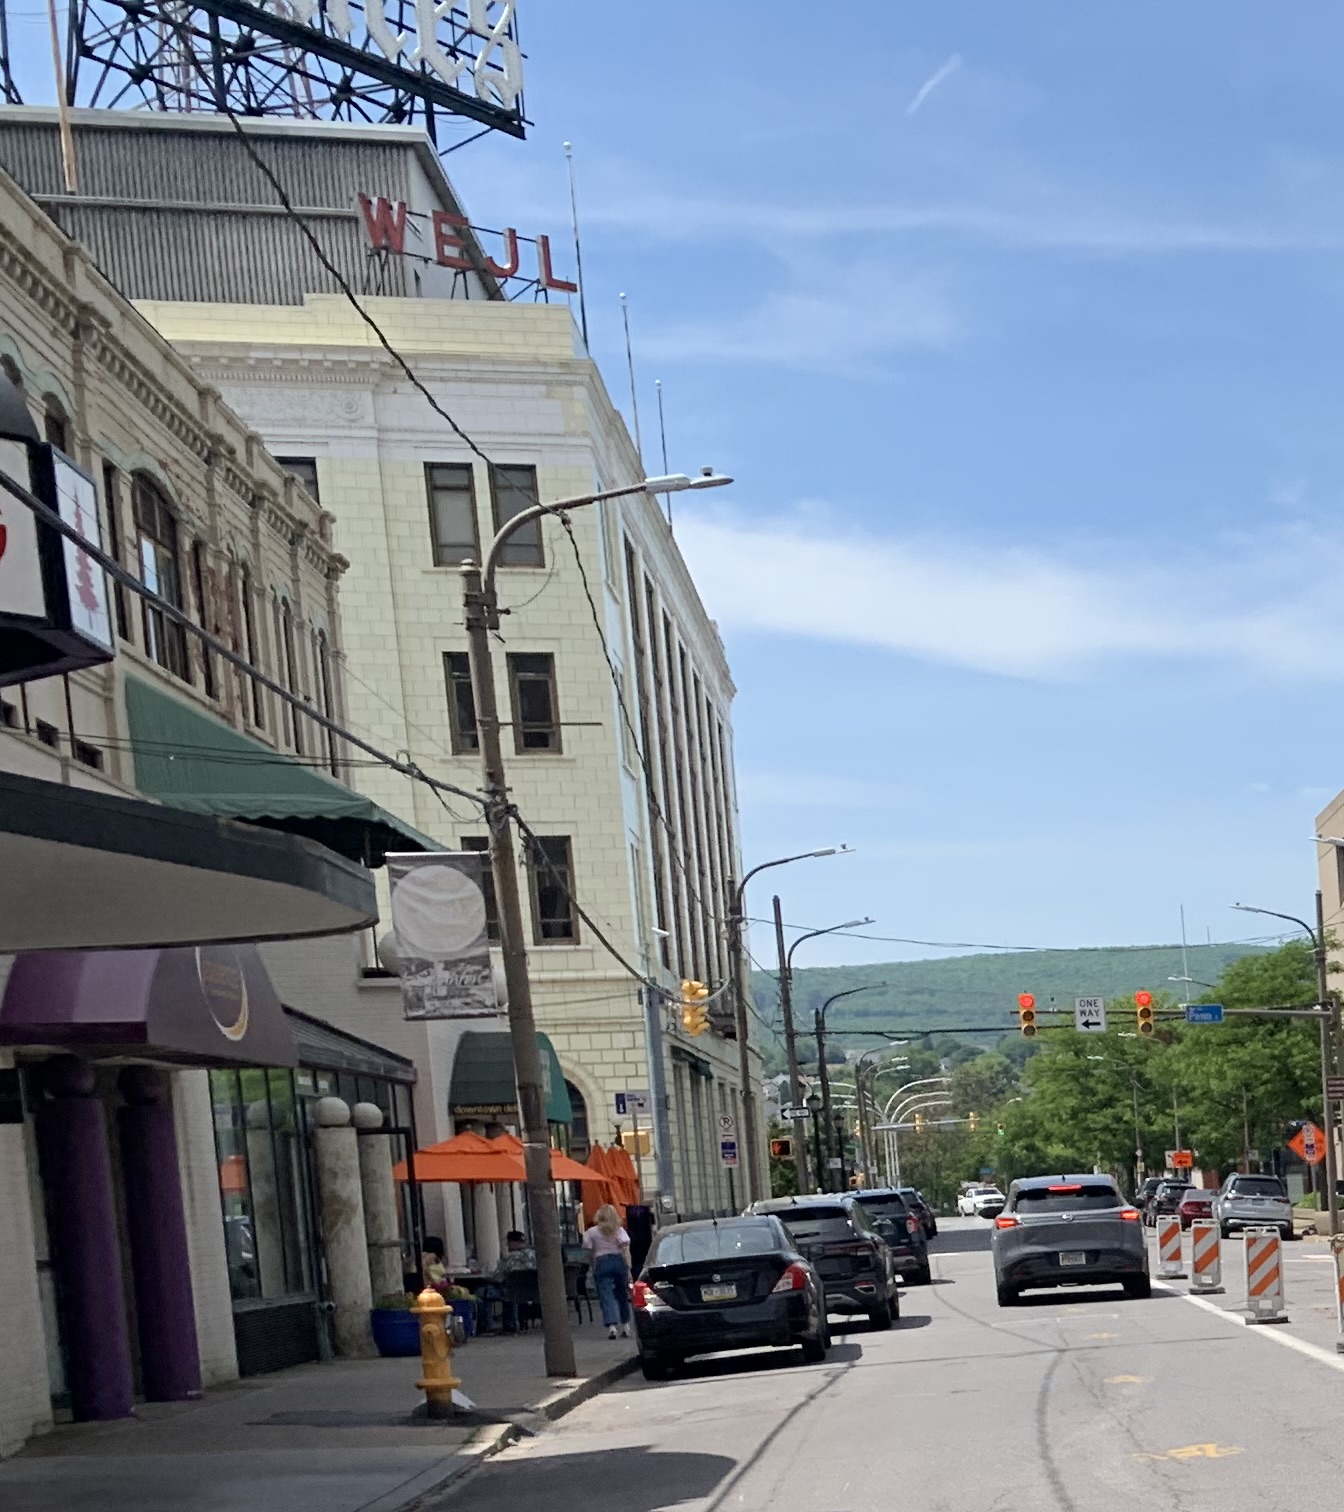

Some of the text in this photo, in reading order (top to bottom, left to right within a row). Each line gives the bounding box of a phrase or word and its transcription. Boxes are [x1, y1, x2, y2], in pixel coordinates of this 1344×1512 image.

[358, 192, 577, 293] WEJL
[1079, 999, 1099, 1008] ONE
[1079, 1009, 1100, 1017] WAY
